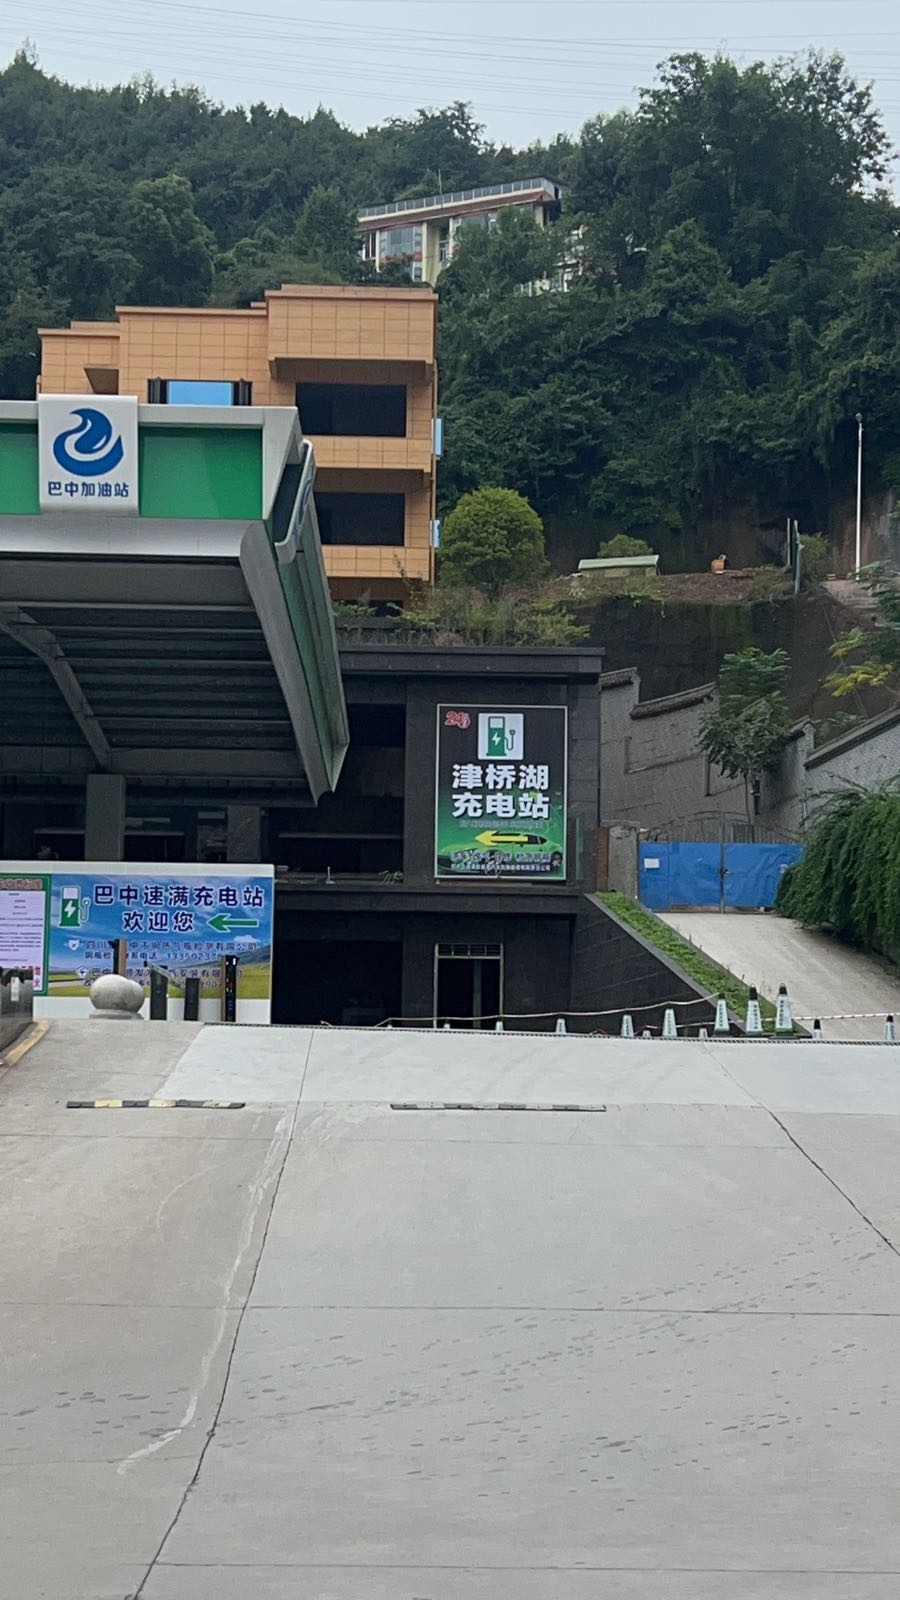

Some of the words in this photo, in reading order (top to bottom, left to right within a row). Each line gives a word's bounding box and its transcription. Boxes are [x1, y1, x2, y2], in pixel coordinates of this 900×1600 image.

[48, 482, 129, 497] 巴中加油站
[452, 763, 549, 790] 津桥湖
[452, 792, 550, 819] 充电站
[94, 885, 264, 908] 巴中速满充电站
[123, 912, 194, 931] 欢迎您
